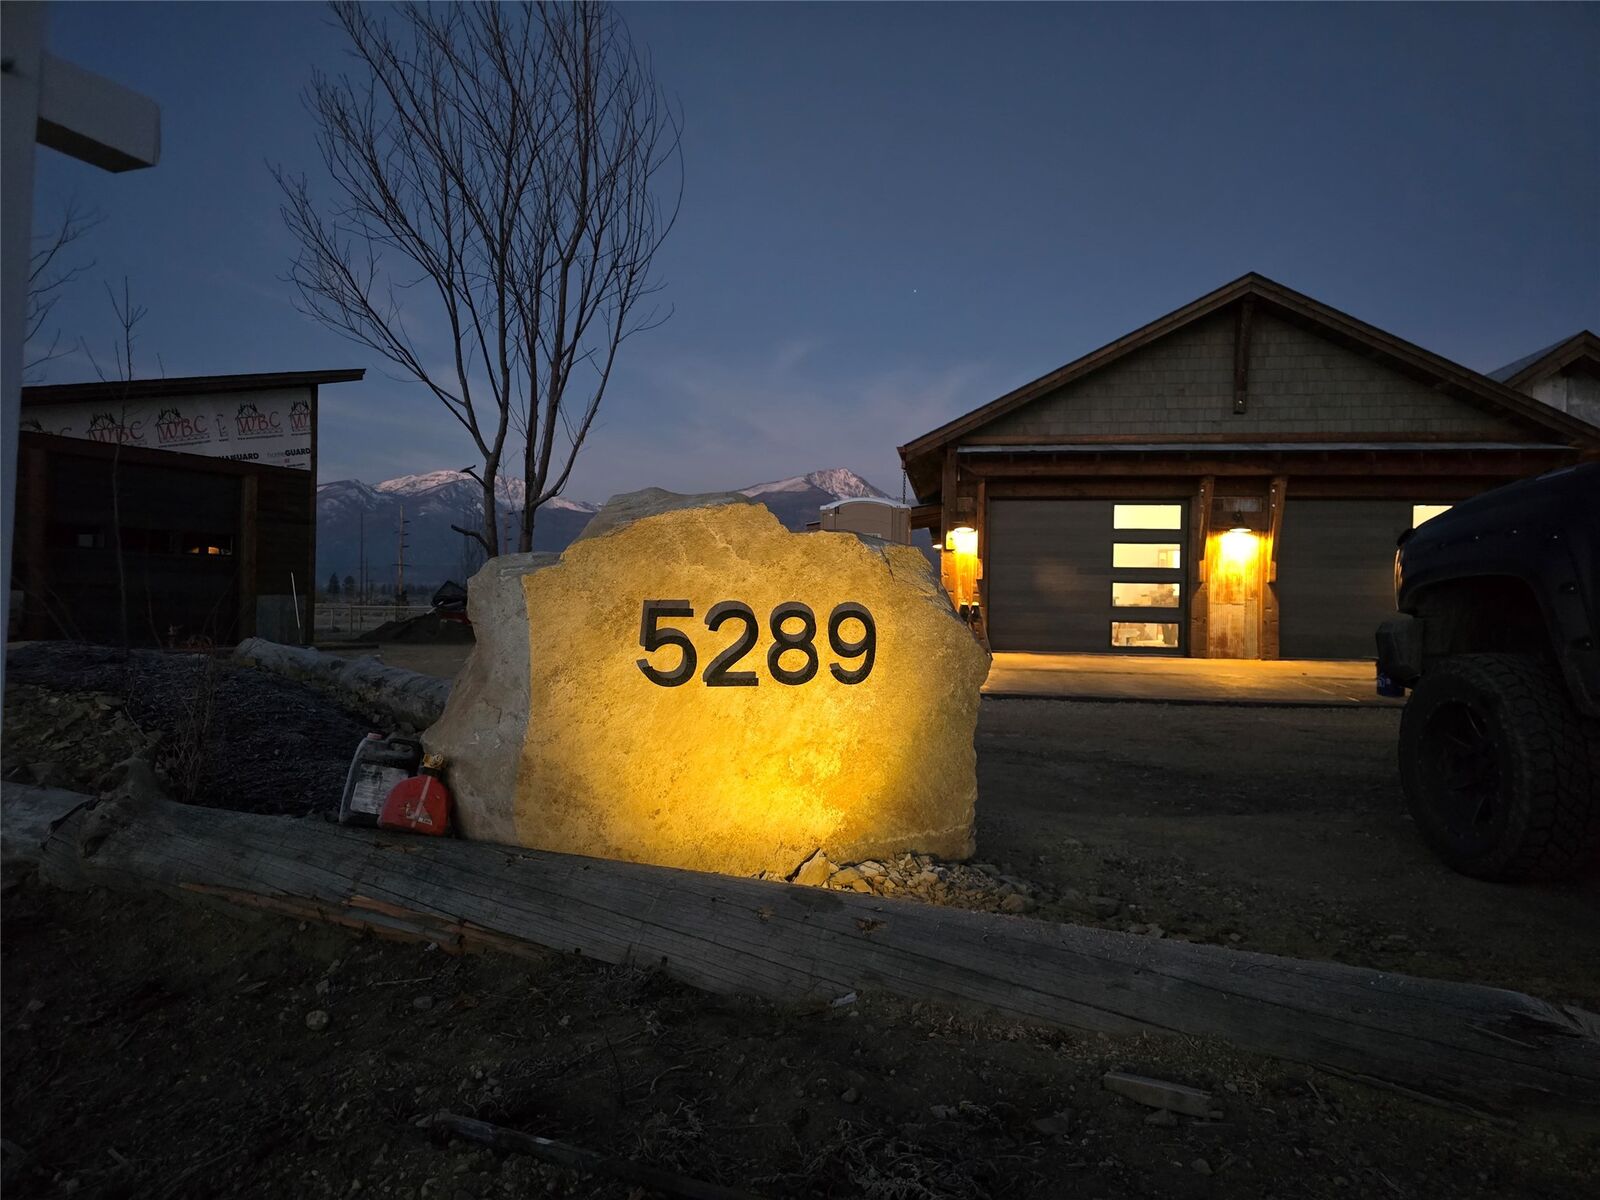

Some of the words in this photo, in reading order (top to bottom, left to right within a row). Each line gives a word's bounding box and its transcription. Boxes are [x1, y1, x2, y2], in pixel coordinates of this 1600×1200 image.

[159, 416, 208, 440] WBC
[238, 411, 281, 433] WBC
[636, 600, 877, 687] 5289
